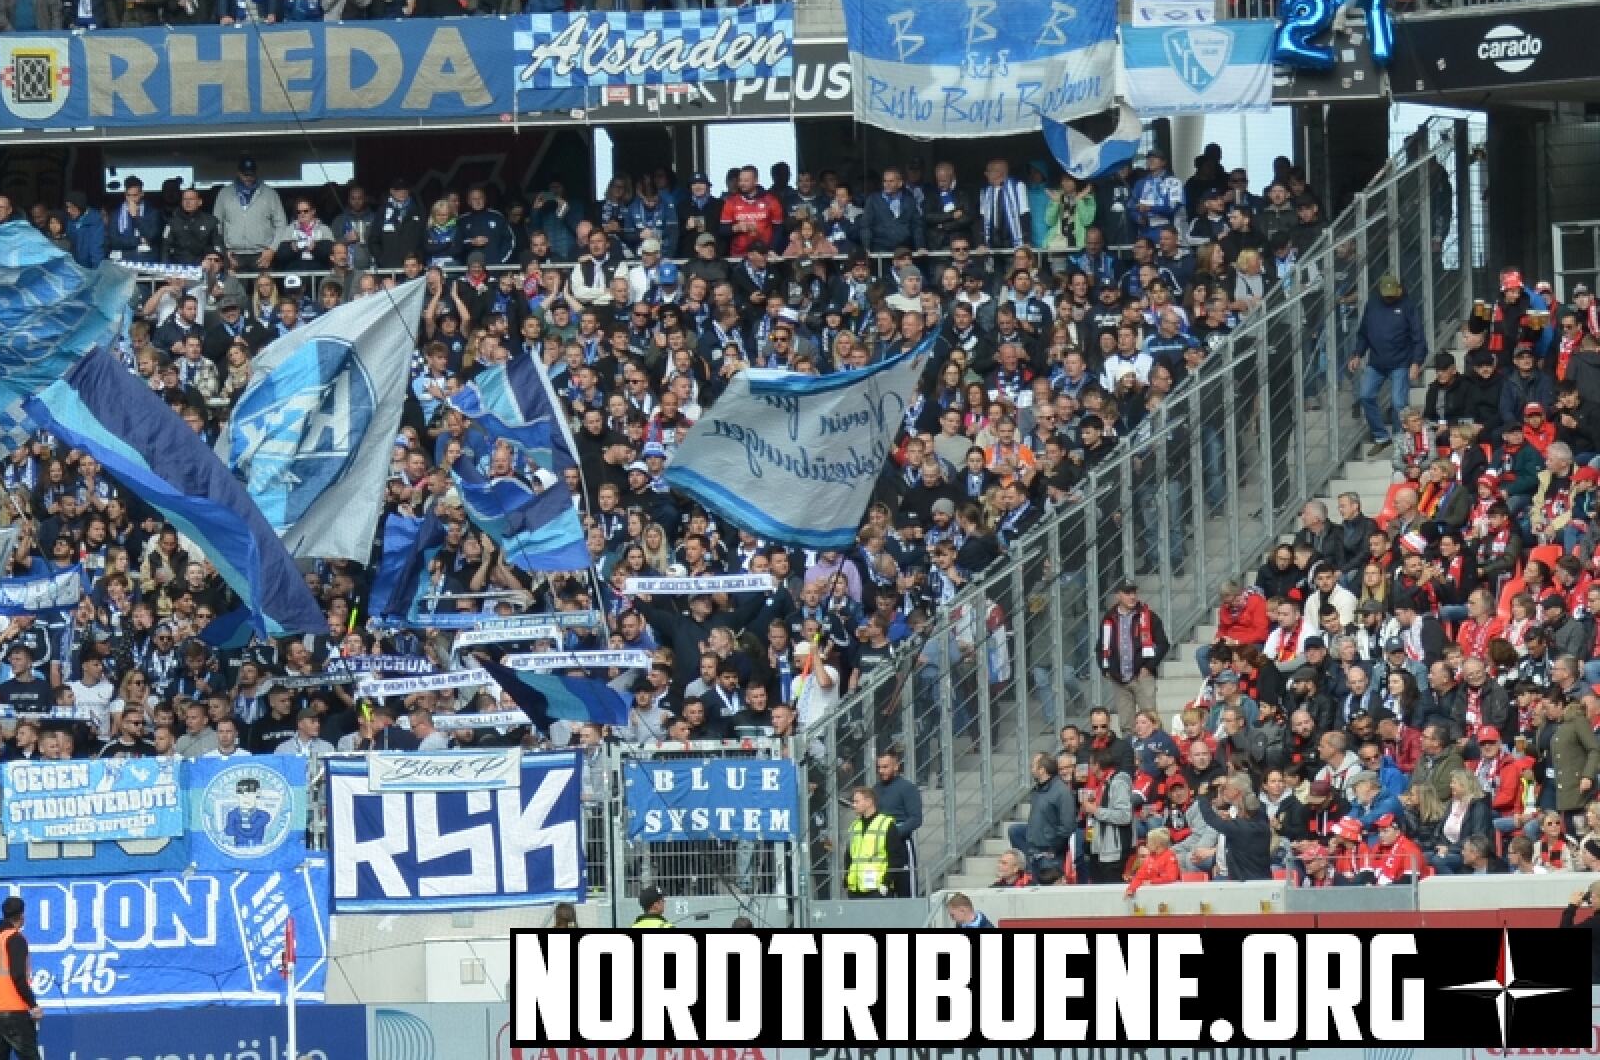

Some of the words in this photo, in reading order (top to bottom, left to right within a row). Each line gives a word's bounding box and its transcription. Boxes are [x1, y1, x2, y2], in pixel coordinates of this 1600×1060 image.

[520, 14, 790, 82] Alstaden
[1477, 34, 1543, 59] carado
[83, 26, 494, 118] RHEDA
[13, 763, 89, 792] GEGEN
[653, 767, 781, 791] BLUE
[331, 768, 579, 897] RSK
[644, 807, 791, 833] SYSTEM
